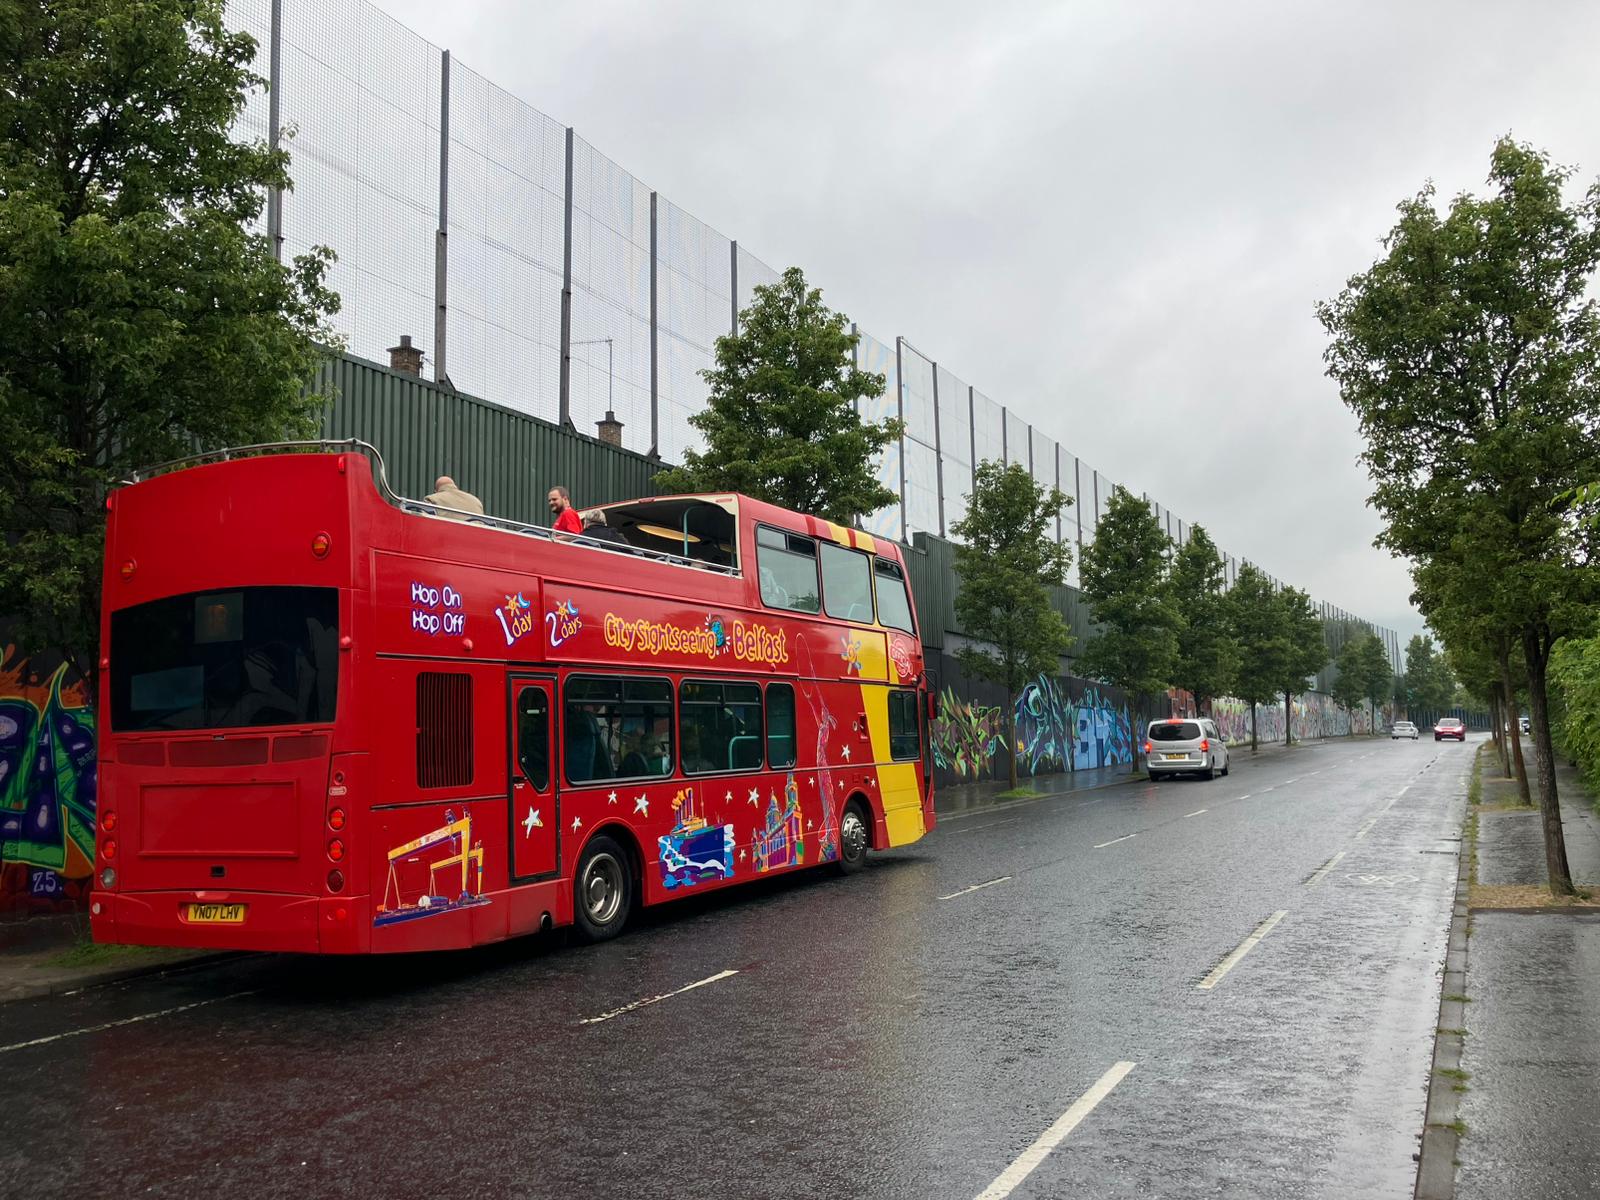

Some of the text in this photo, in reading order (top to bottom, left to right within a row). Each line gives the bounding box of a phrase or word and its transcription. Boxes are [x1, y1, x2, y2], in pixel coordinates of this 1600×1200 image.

[411, 582, 462, 608] Hop On
[411, 610, 466, 635] Hop Off
[495, 608, 533, 647] 1 day
[545, 611, 583, 647] 2 days
[732, 619, 789, 664] Belfast
[193, 904, 240, 919] YN07 LHV
